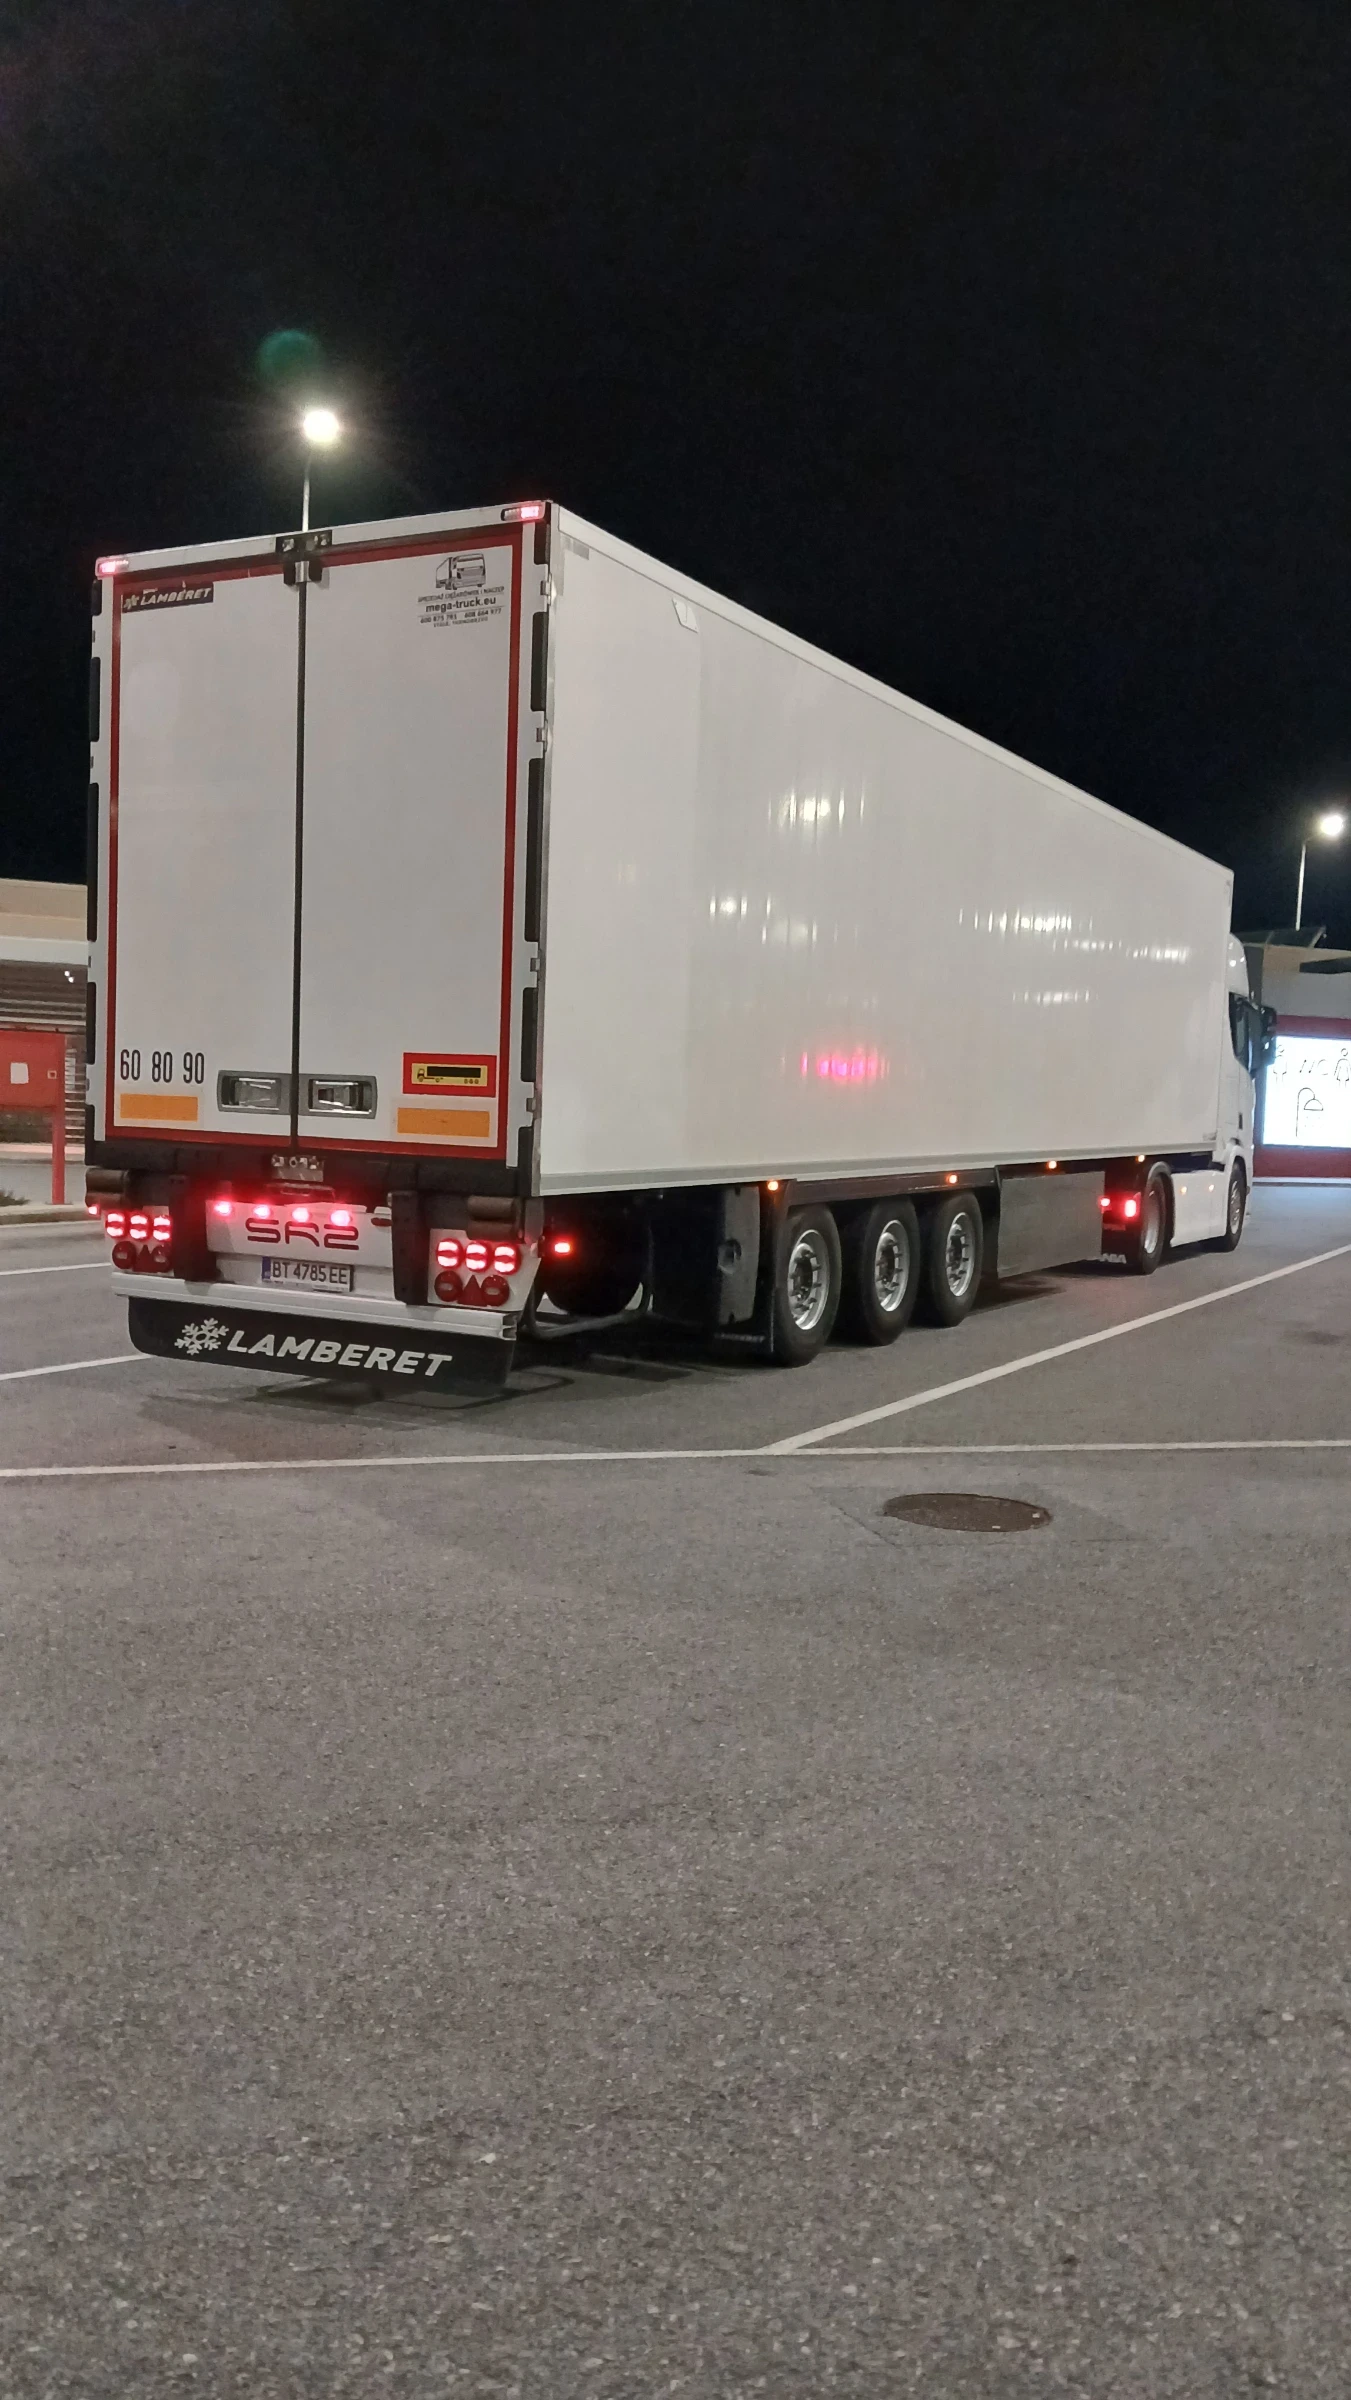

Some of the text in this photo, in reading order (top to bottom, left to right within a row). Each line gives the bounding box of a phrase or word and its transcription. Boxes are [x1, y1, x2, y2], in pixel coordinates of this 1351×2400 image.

[141, 588, 211, 606] LAMBERET
[426, 596, 496, 613] mega-truck.eu
[120, 1049, 205, 1084] 60 80 90
[272, 1261, 291, 1278] BT
[293, 1262, 327, 1282] 4785
[329, 1266, 348, 1284] EE
[226, 1330, 453, 1377] LAMBERET
